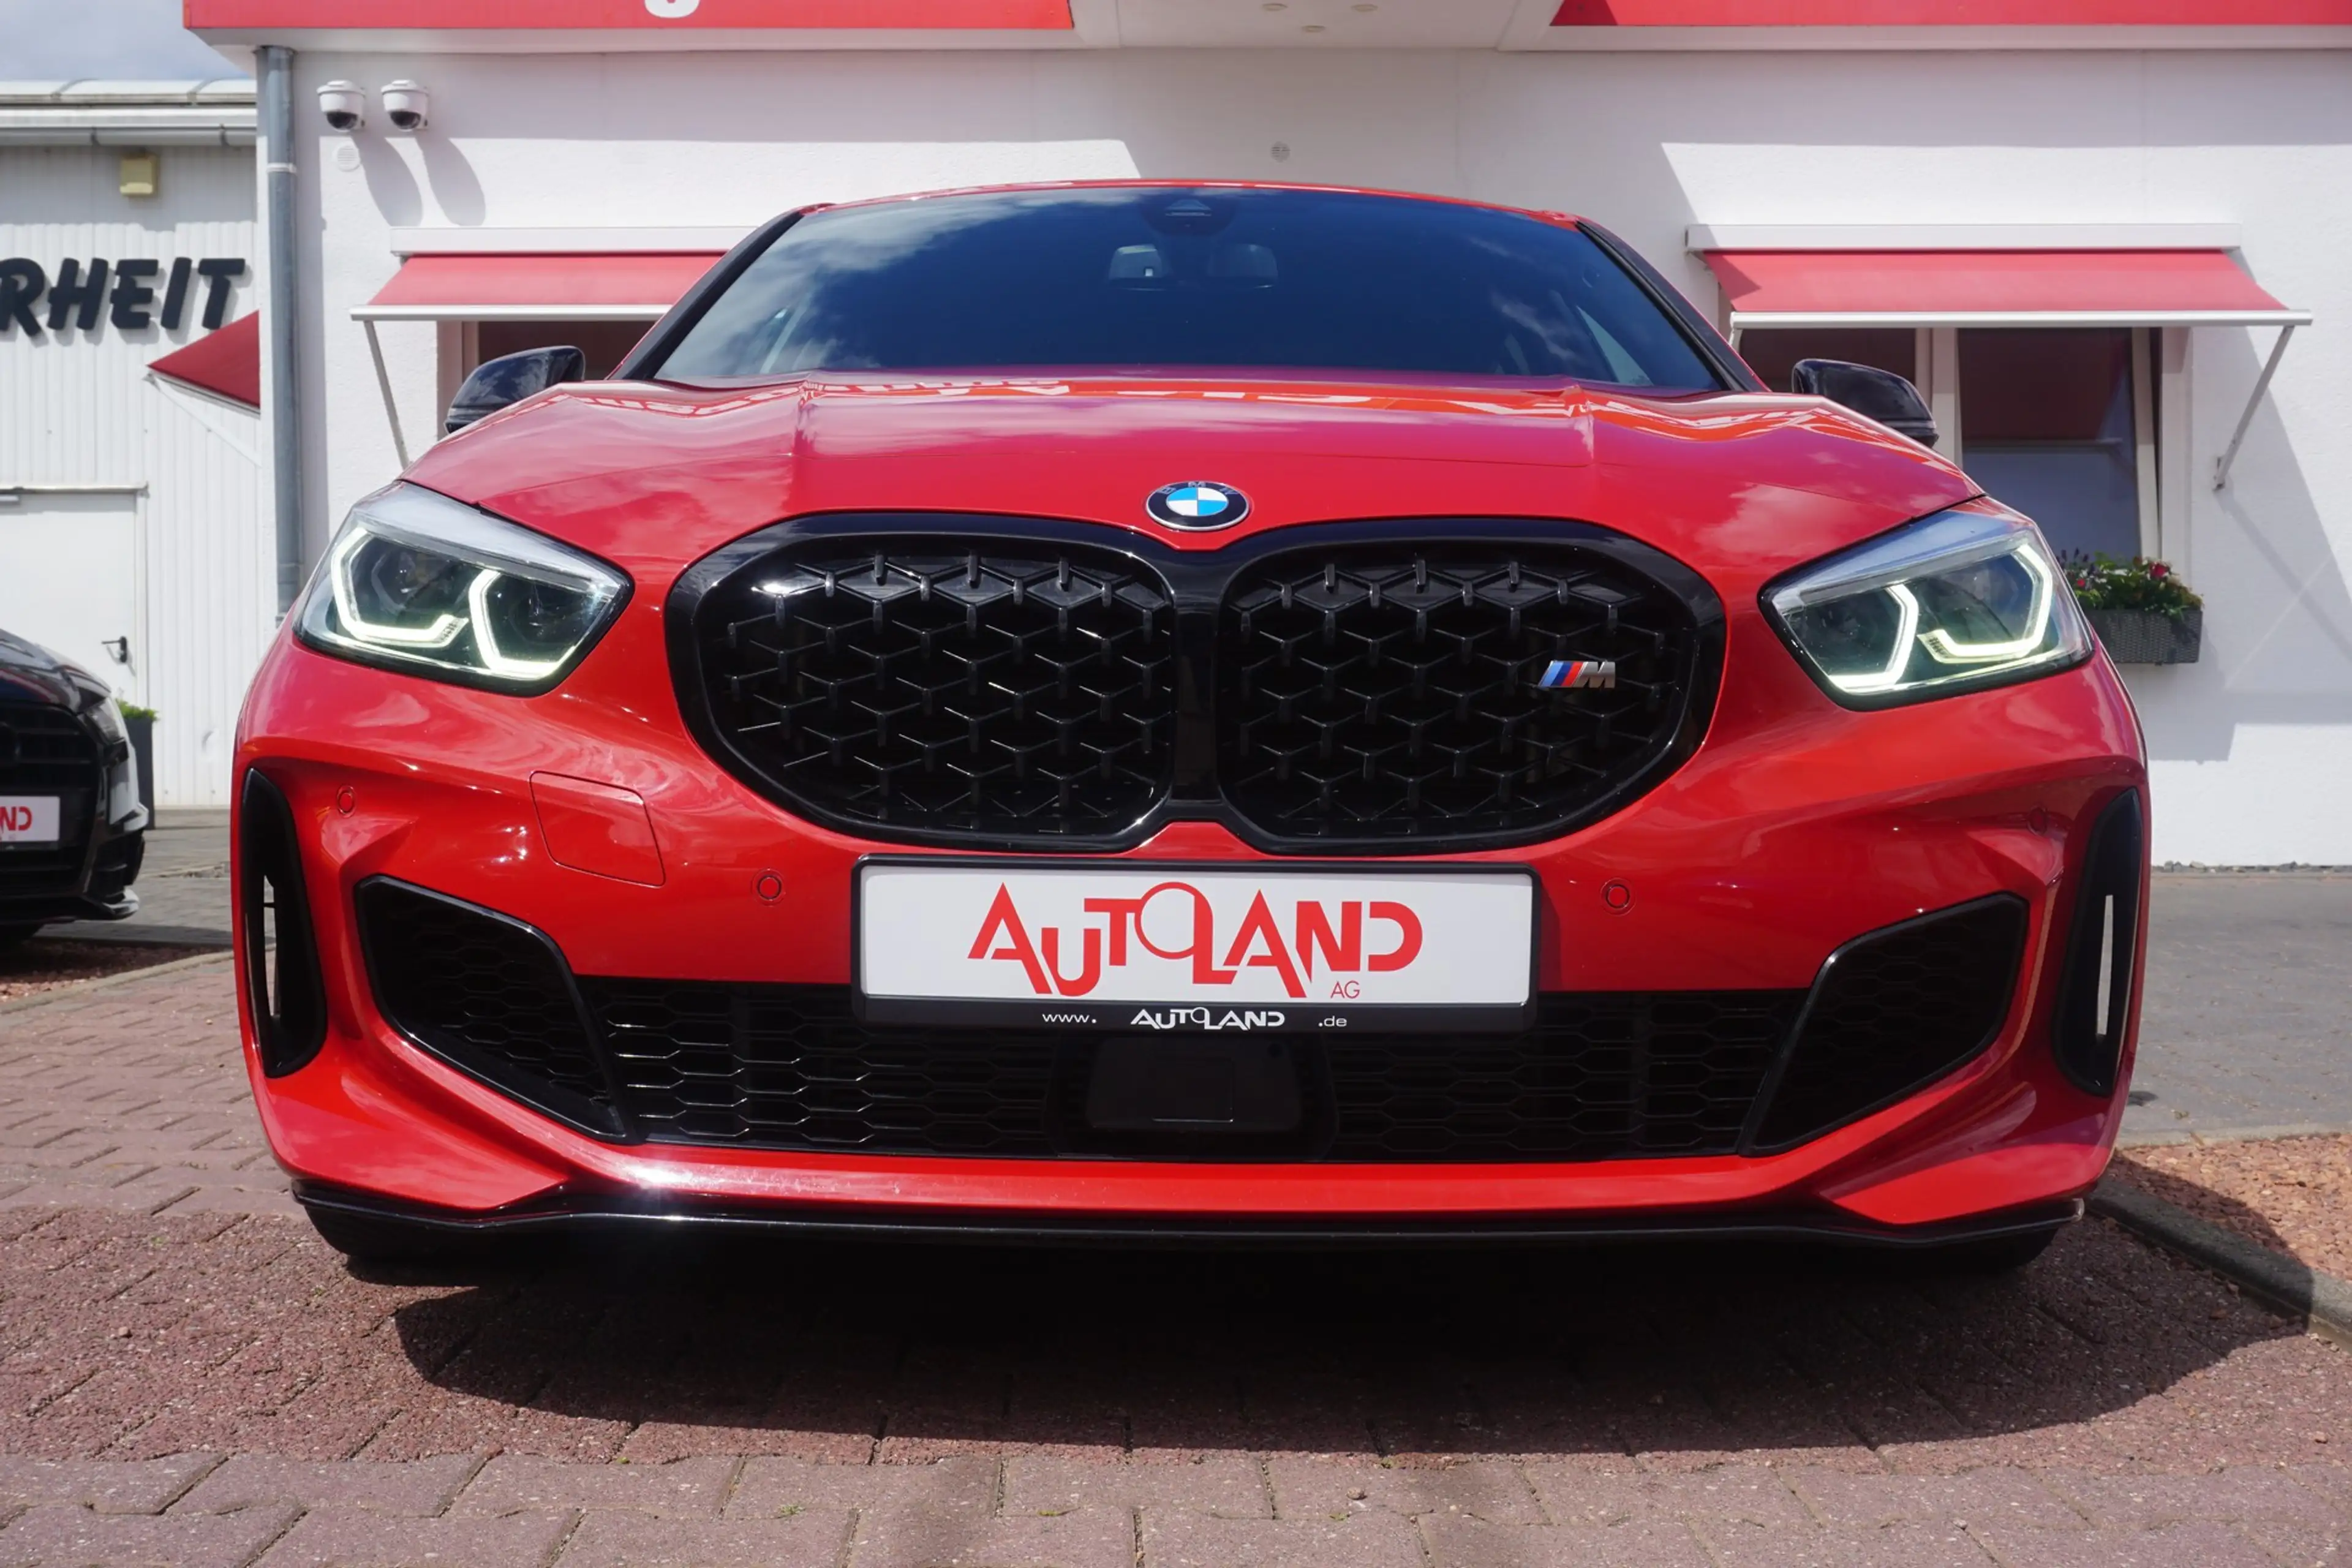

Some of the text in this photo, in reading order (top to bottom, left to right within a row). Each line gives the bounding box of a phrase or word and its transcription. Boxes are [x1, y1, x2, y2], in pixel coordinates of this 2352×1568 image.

[0, 257, 246, 337] RHEIT
[968, 881, 1423, 999] AUTOLAND
[1330, 980, 1360, 999] AG
[1042, 1006, 1348, 1031] www. AUTOLAND .de
